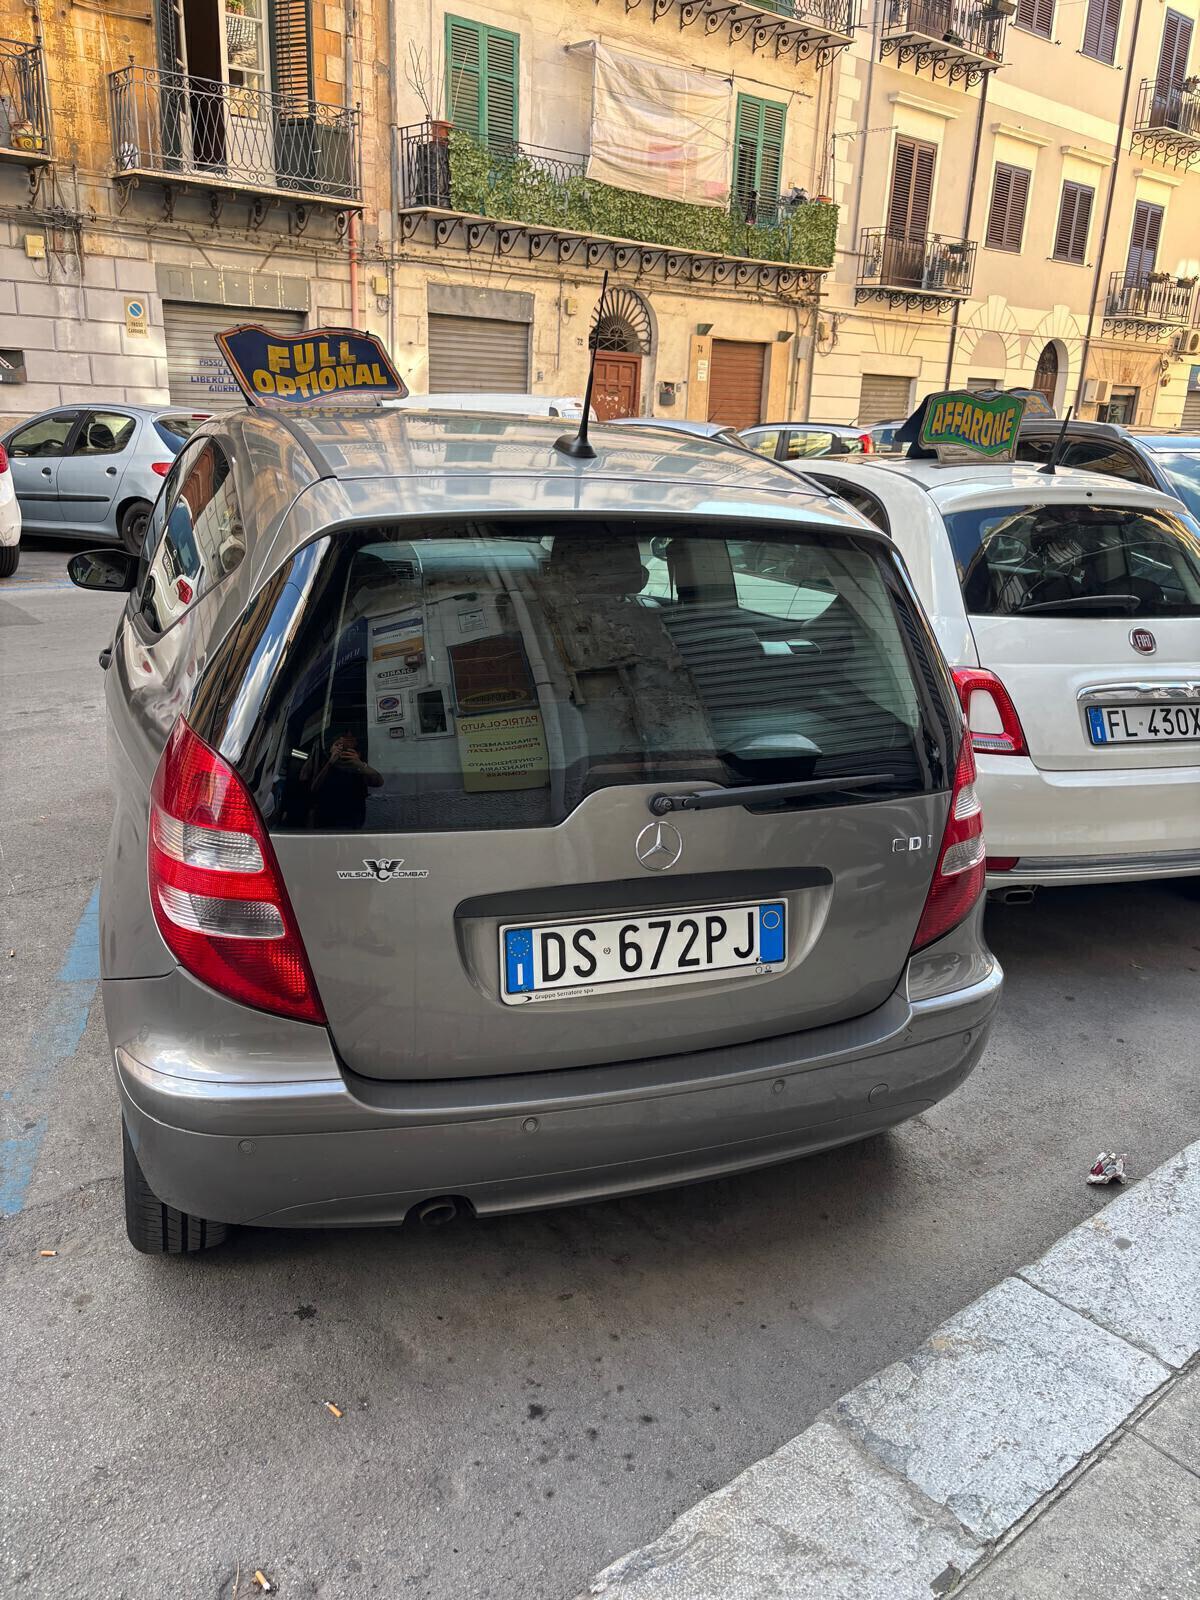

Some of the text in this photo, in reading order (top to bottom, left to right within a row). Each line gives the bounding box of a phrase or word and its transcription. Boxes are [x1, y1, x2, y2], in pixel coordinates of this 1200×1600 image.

[267, 341, 357, 374] FULL
[576, 338, 583, 346] 72
[199, 359, 223, 367] PASSO
[191, 375, 225, 384] LIBERO
[252, 363, 388, 398] OPTIONAL
[931, 400, 1016, 447] AFFARONE
[1106, 709, 1138, 738] FL
[540, 911, 754, 983] DS 672PJ
